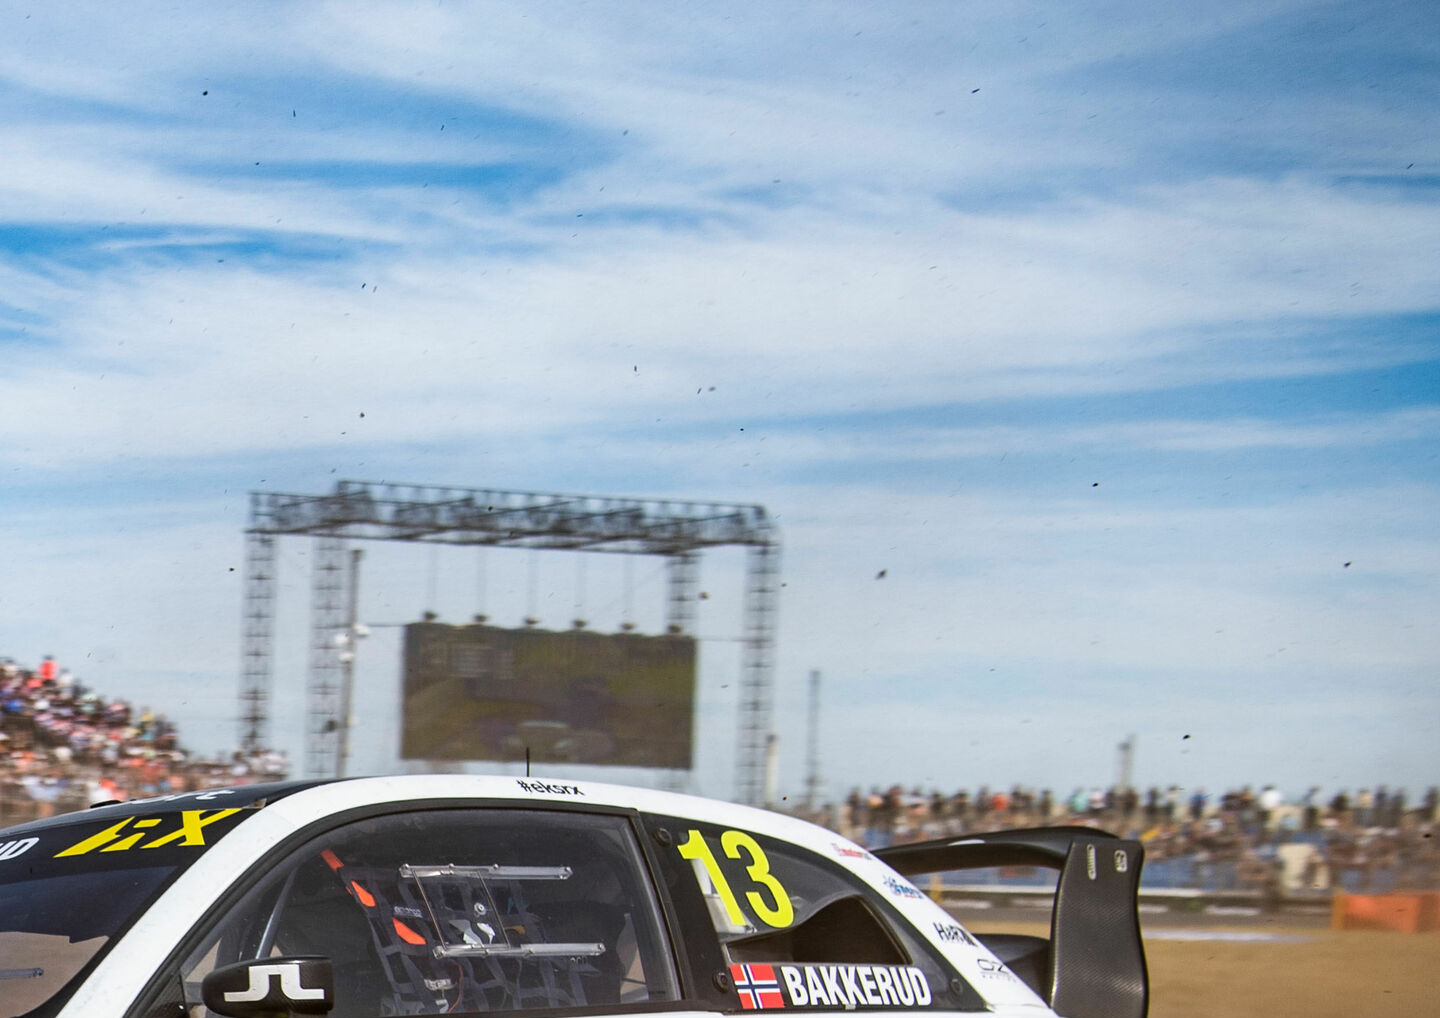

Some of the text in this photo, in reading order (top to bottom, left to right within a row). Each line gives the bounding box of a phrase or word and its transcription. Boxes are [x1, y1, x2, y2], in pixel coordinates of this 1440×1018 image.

[517, 779, 585, 797] #eksrx
[677, 829, 795, 929] 13
[781, 965, 933, 1006] BAKKERUD
